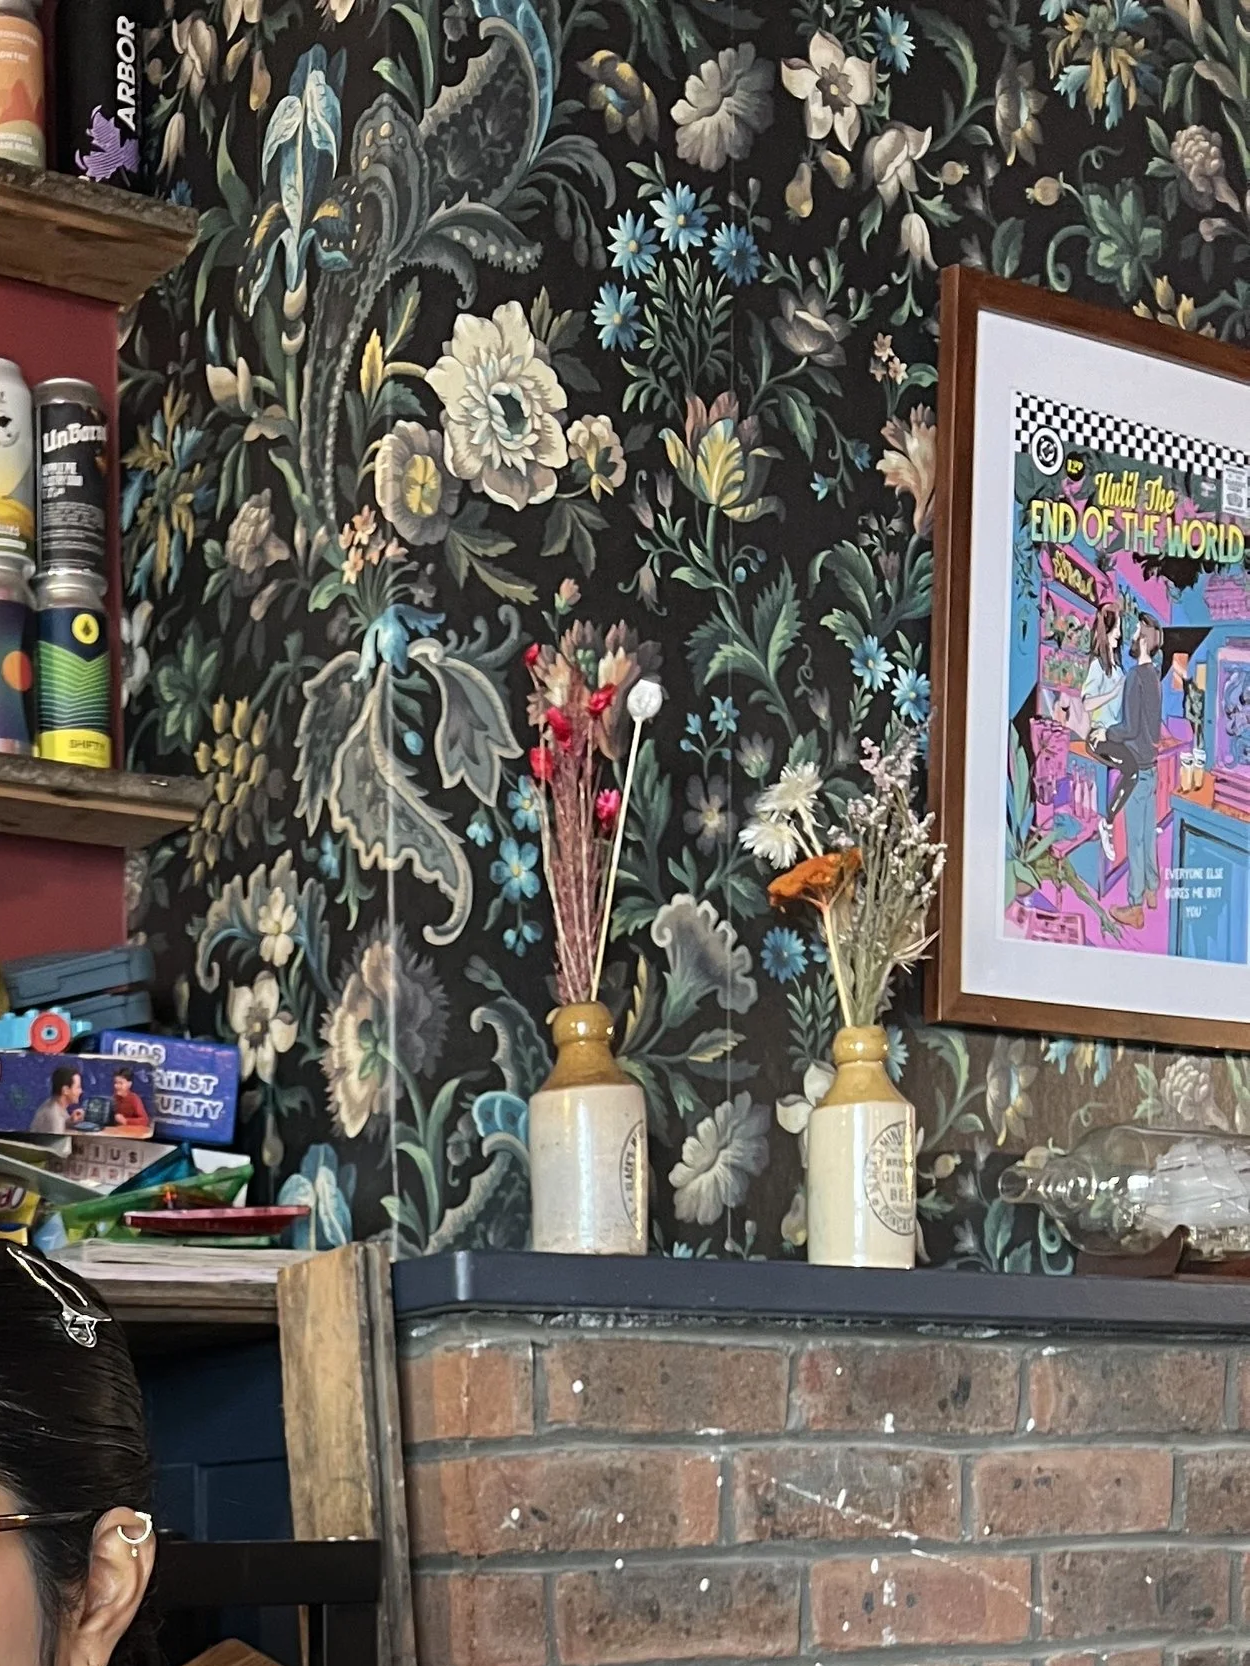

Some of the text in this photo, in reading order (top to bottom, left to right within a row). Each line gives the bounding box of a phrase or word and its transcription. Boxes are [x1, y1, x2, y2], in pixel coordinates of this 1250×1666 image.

[116, 15, 137, 132] ARBOR
[1094, 469, 1140, 509] Until
[1143, 475, 1176, 515] The
[1030, 499, 1246, 564] END OF THE WORLD
